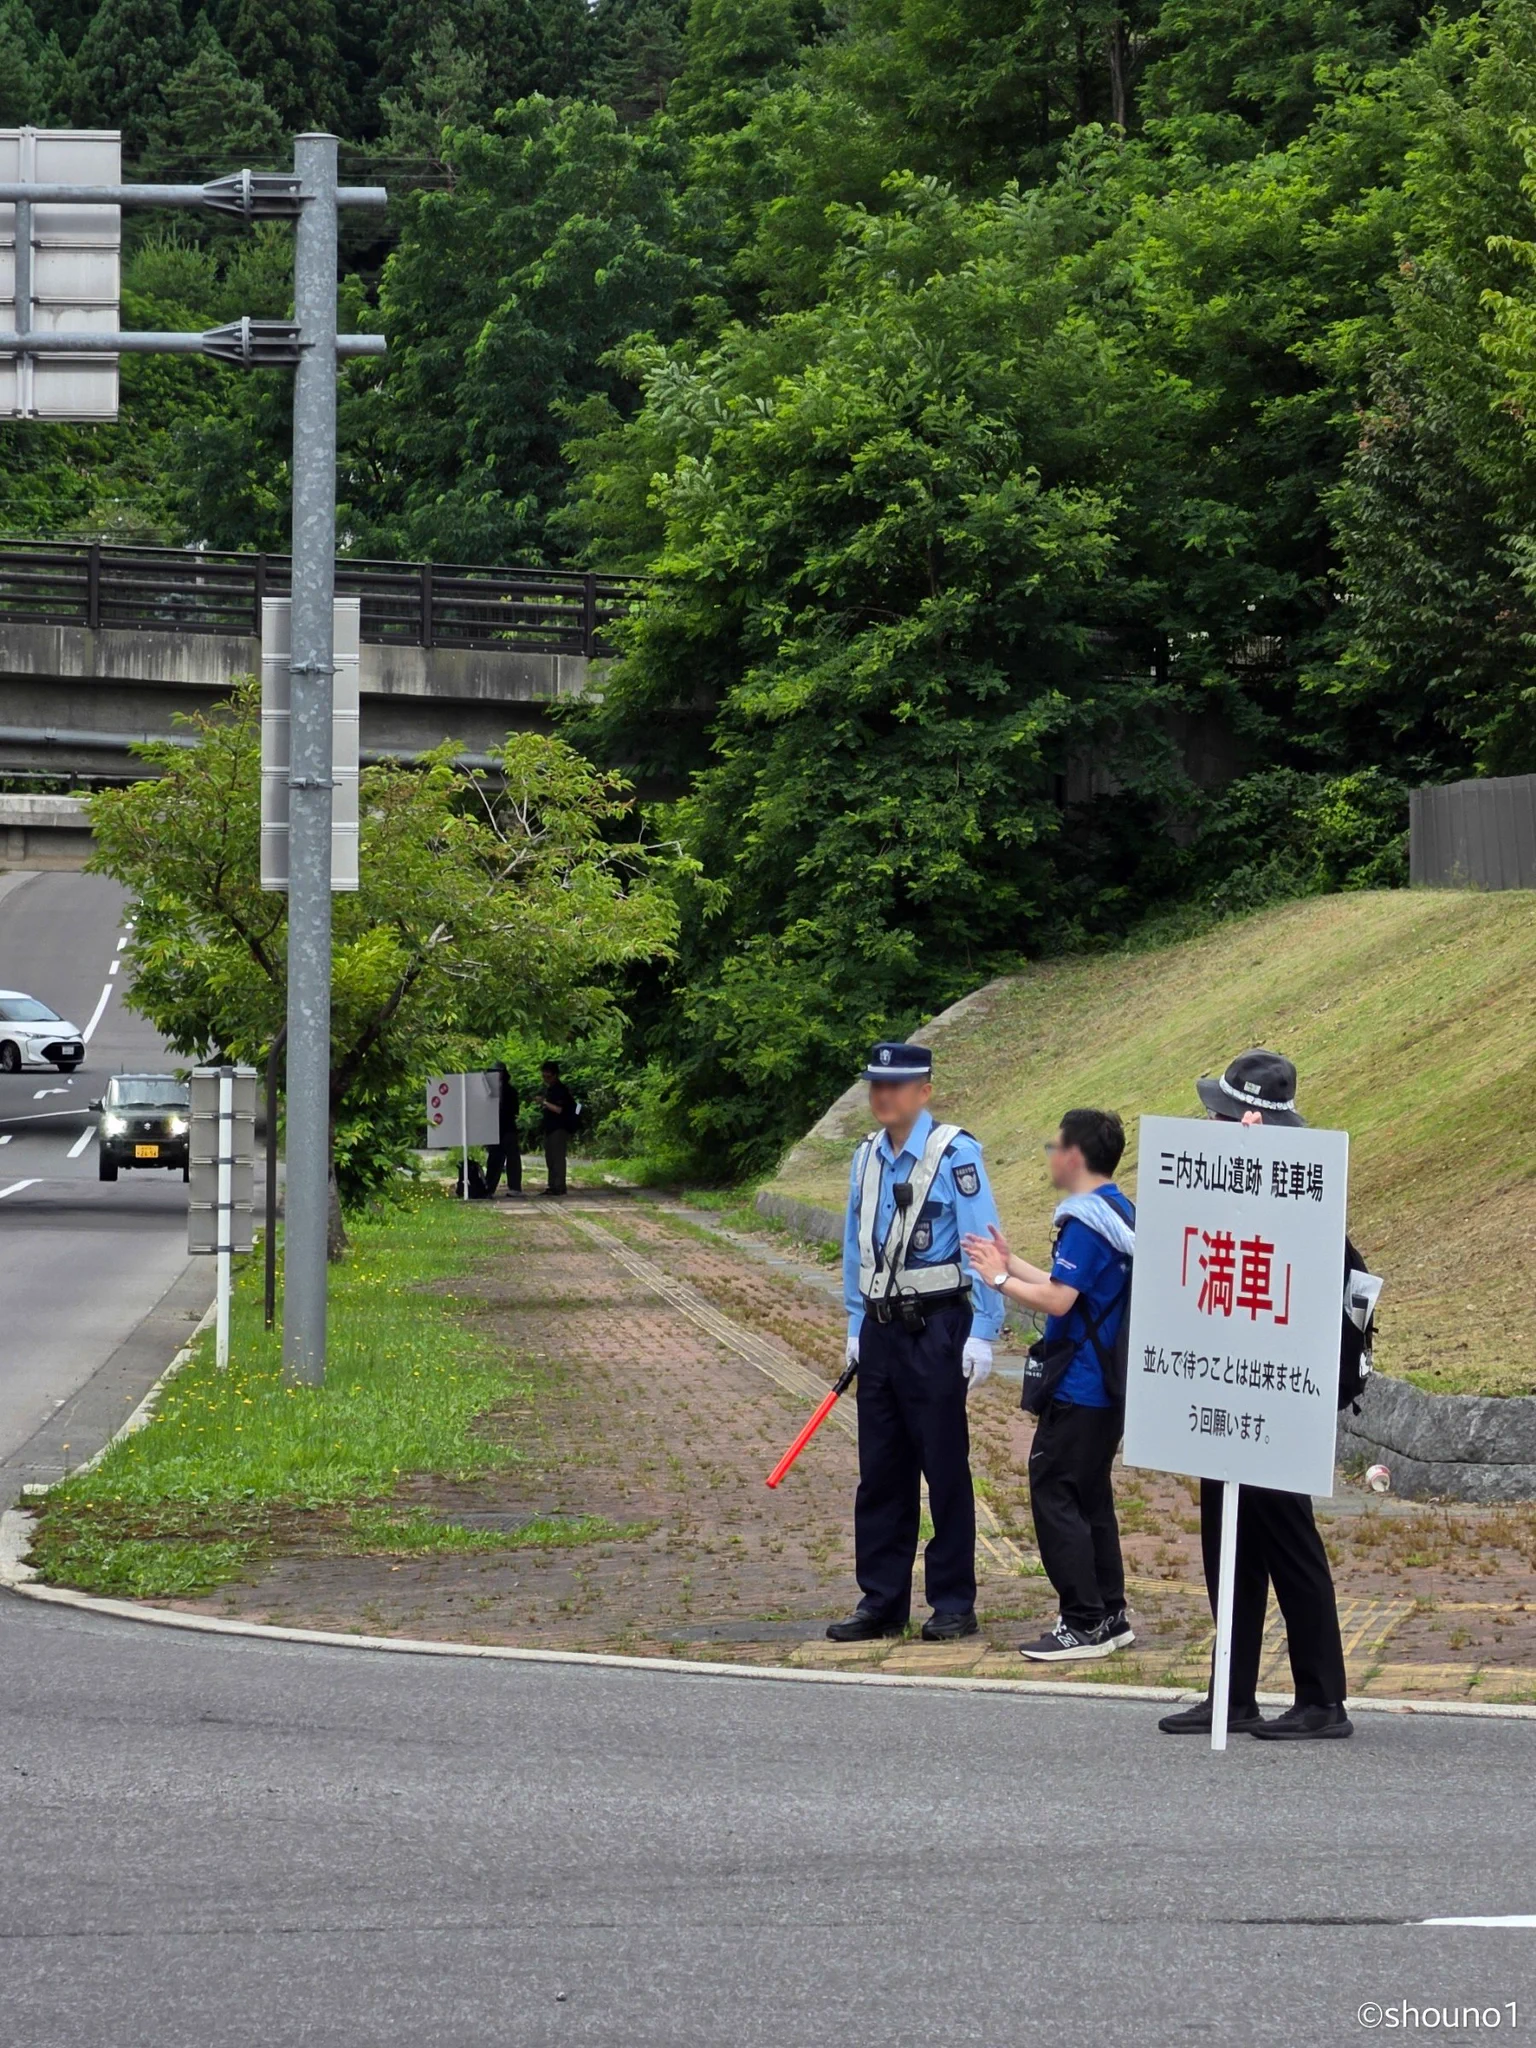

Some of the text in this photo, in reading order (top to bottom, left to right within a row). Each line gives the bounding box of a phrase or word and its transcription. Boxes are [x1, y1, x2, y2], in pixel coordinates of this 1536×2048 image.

[1158, 1150, 1324, 1203] 三内丸山遺跡 駐車場
[1182, 1226, 1291, 1325] 「満車」
[1143, 1345, 1321, 1397] 並んで待つことは出来ません、
[1188, 1404, 1271, 1445] う回願います。
[1057, 1632, 1079, 1647] N
